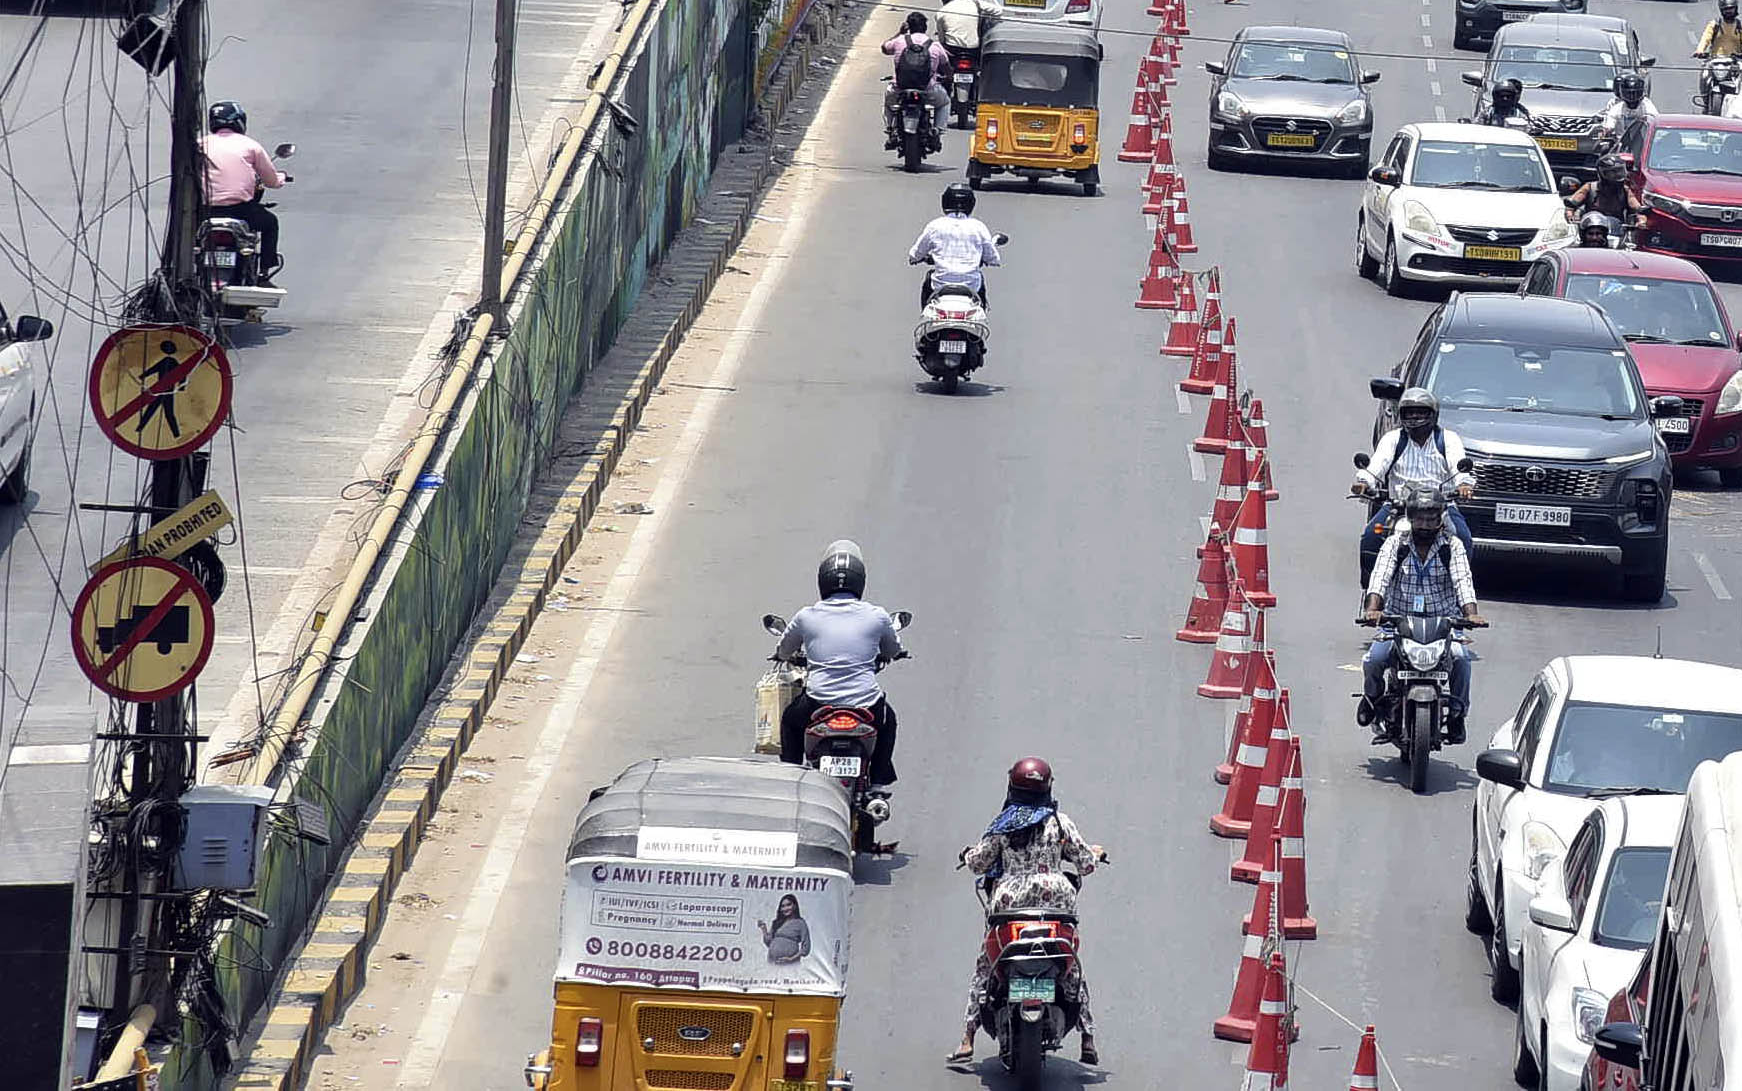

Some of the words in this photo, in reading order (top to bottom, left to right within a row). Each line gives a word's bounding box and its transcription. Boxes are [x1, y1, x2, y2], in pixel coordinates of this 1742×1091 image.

[1542, 511, 1569, 523] 9980
[643, 841, 671, 853] AMVI
[673, 842, 720, 855] FERTILITY
[732, 845, 788, 857] MATERNITY
[611, 867, 652, 884] AMVI
[658, 870, 728, 888] FERTILITY
[730, 874, 741, 888] &
[746, 874, 829, 892] MATERNITY
[679, 901, 739, 914] Laparoscopy
[607, 912, 657, 925] Pregnancy
[607, 940, 743, 962] 8008842200
